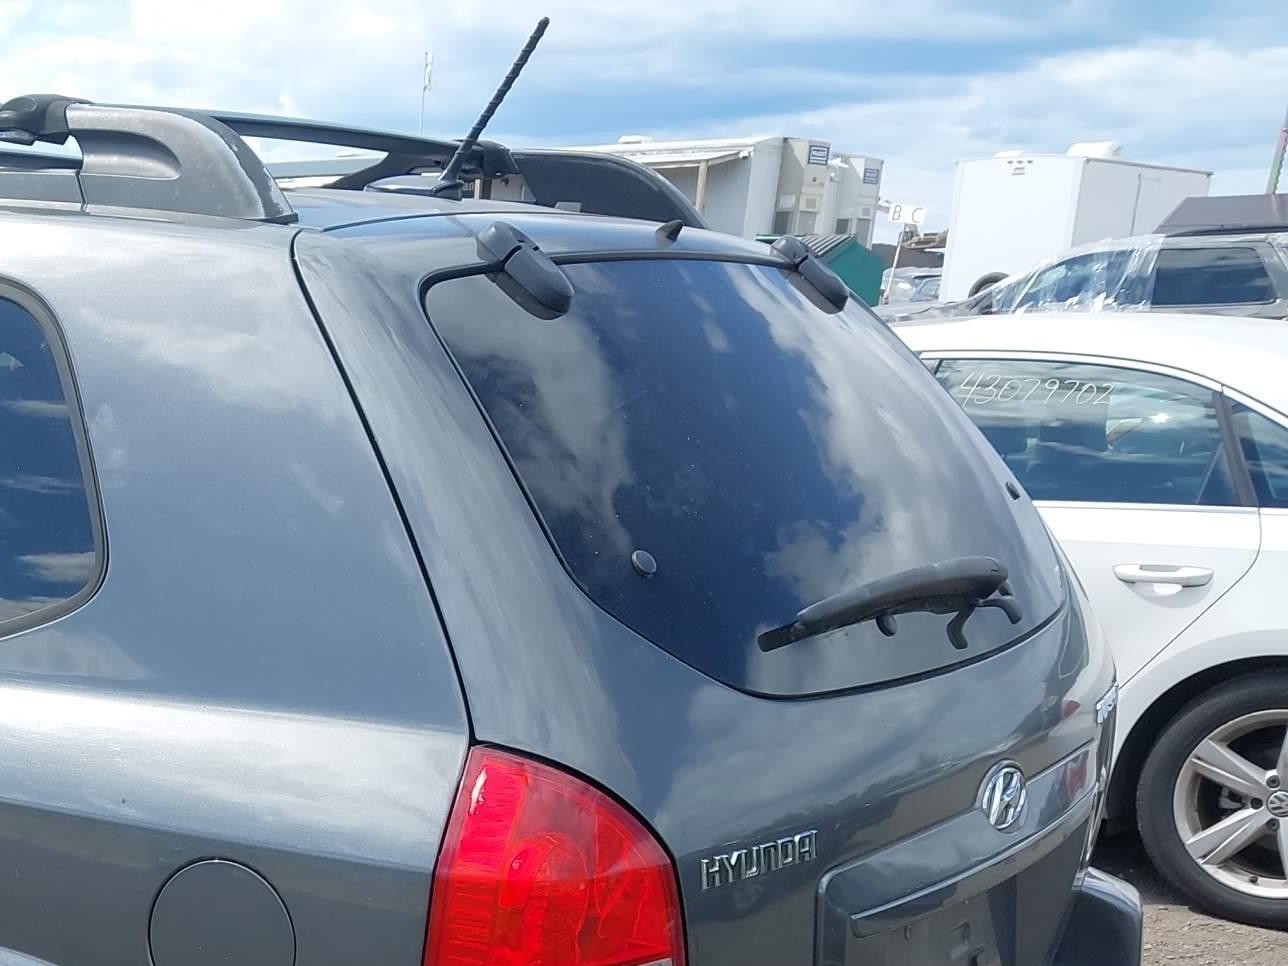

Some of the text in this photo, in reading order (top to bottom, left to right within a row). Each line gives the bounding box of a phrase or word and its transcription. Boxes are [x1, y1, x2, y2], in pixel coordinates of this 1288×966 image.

[892, 204, 924, 224] B C
[960, 371, 1114, 410] 43079702
[700, 829, 819, 890] HYUNDAI
